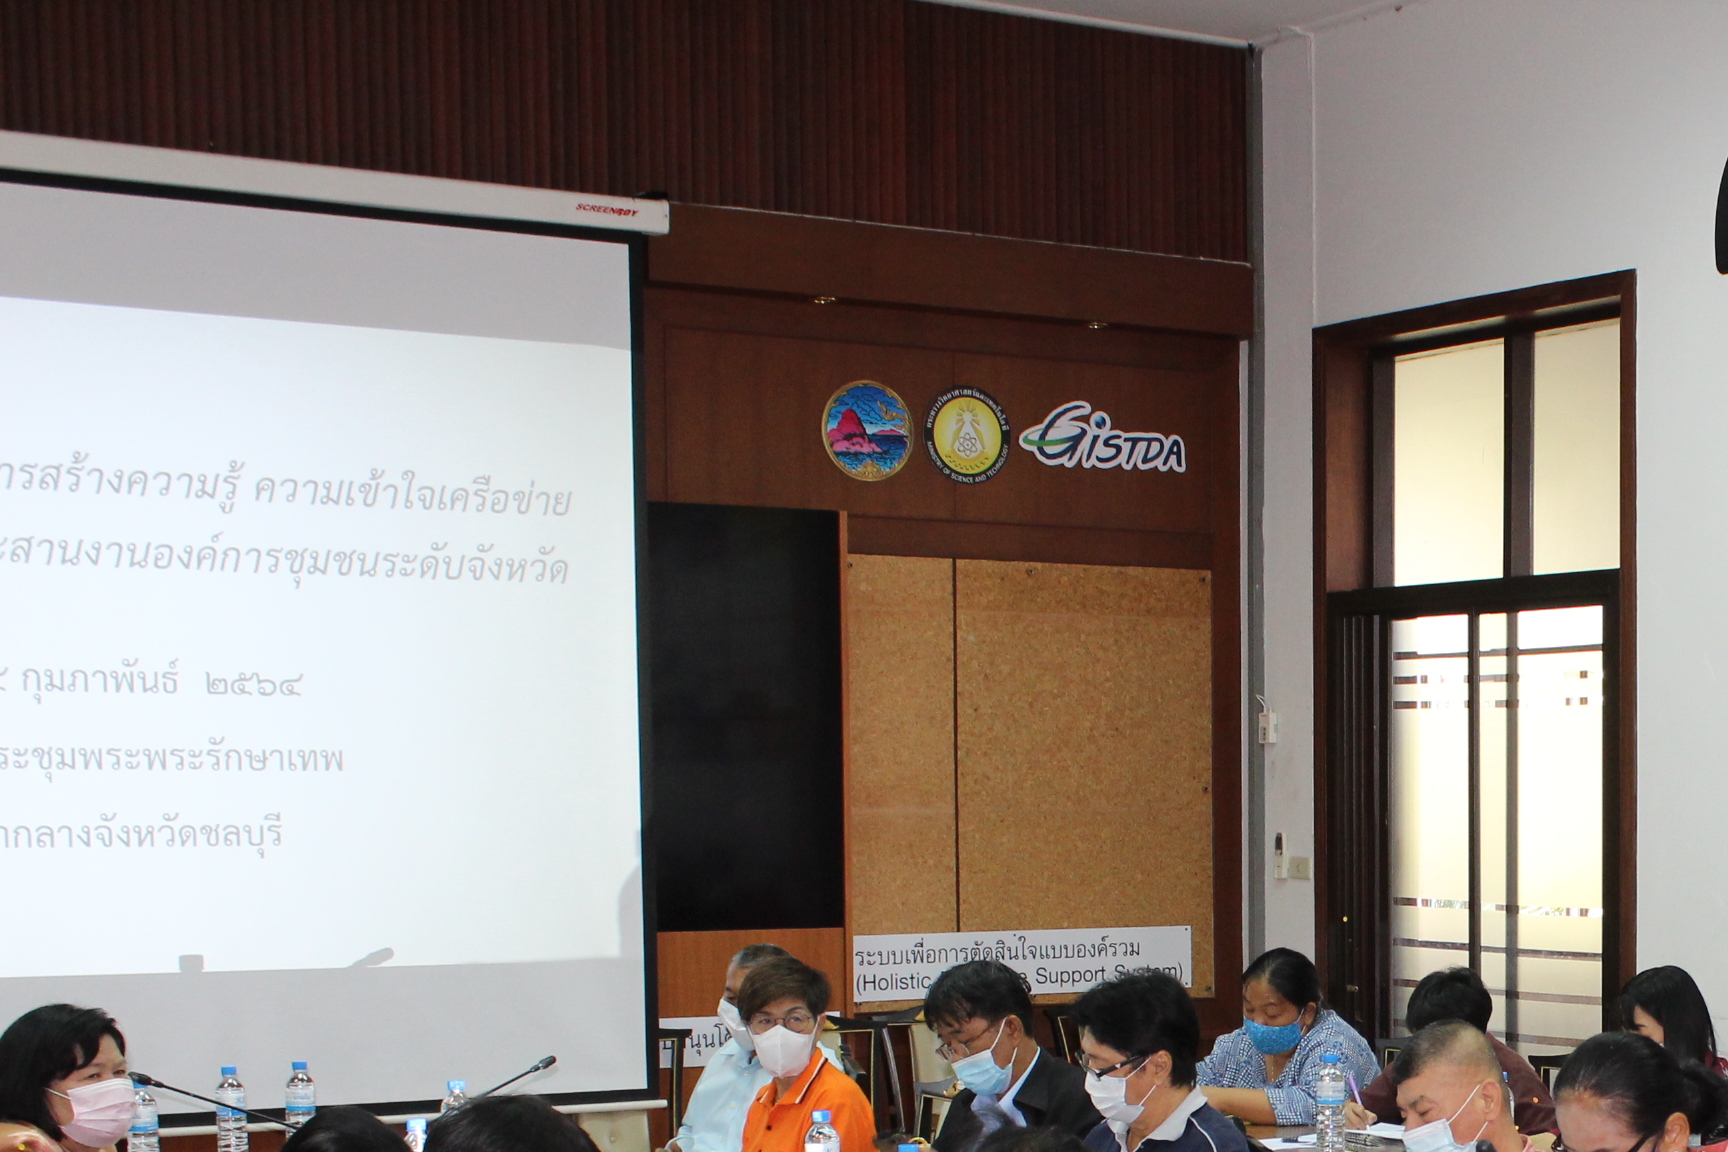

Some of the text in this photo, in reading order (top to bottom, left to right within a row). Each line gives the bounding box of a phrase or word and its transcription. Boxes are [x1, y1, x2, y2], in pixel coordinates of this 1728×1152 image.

[926, 441, 1009, 484] MINISTRY OF SCIENCE AND TECHNOLOGY
[255, 469, 572, 516] ความเข้าใจเครือข่าย
[22, 658, 179, 704] กุมภาพันธ์
[205, 671, 304, 697] ๒๕๖๔
[855, 934, 1140, 969] ระบบเพื่อการตัดสินใจแบบองค์รวม
[855, 971, 931, 994] (Holistic
[1036, 966, 1106, 988] Support
